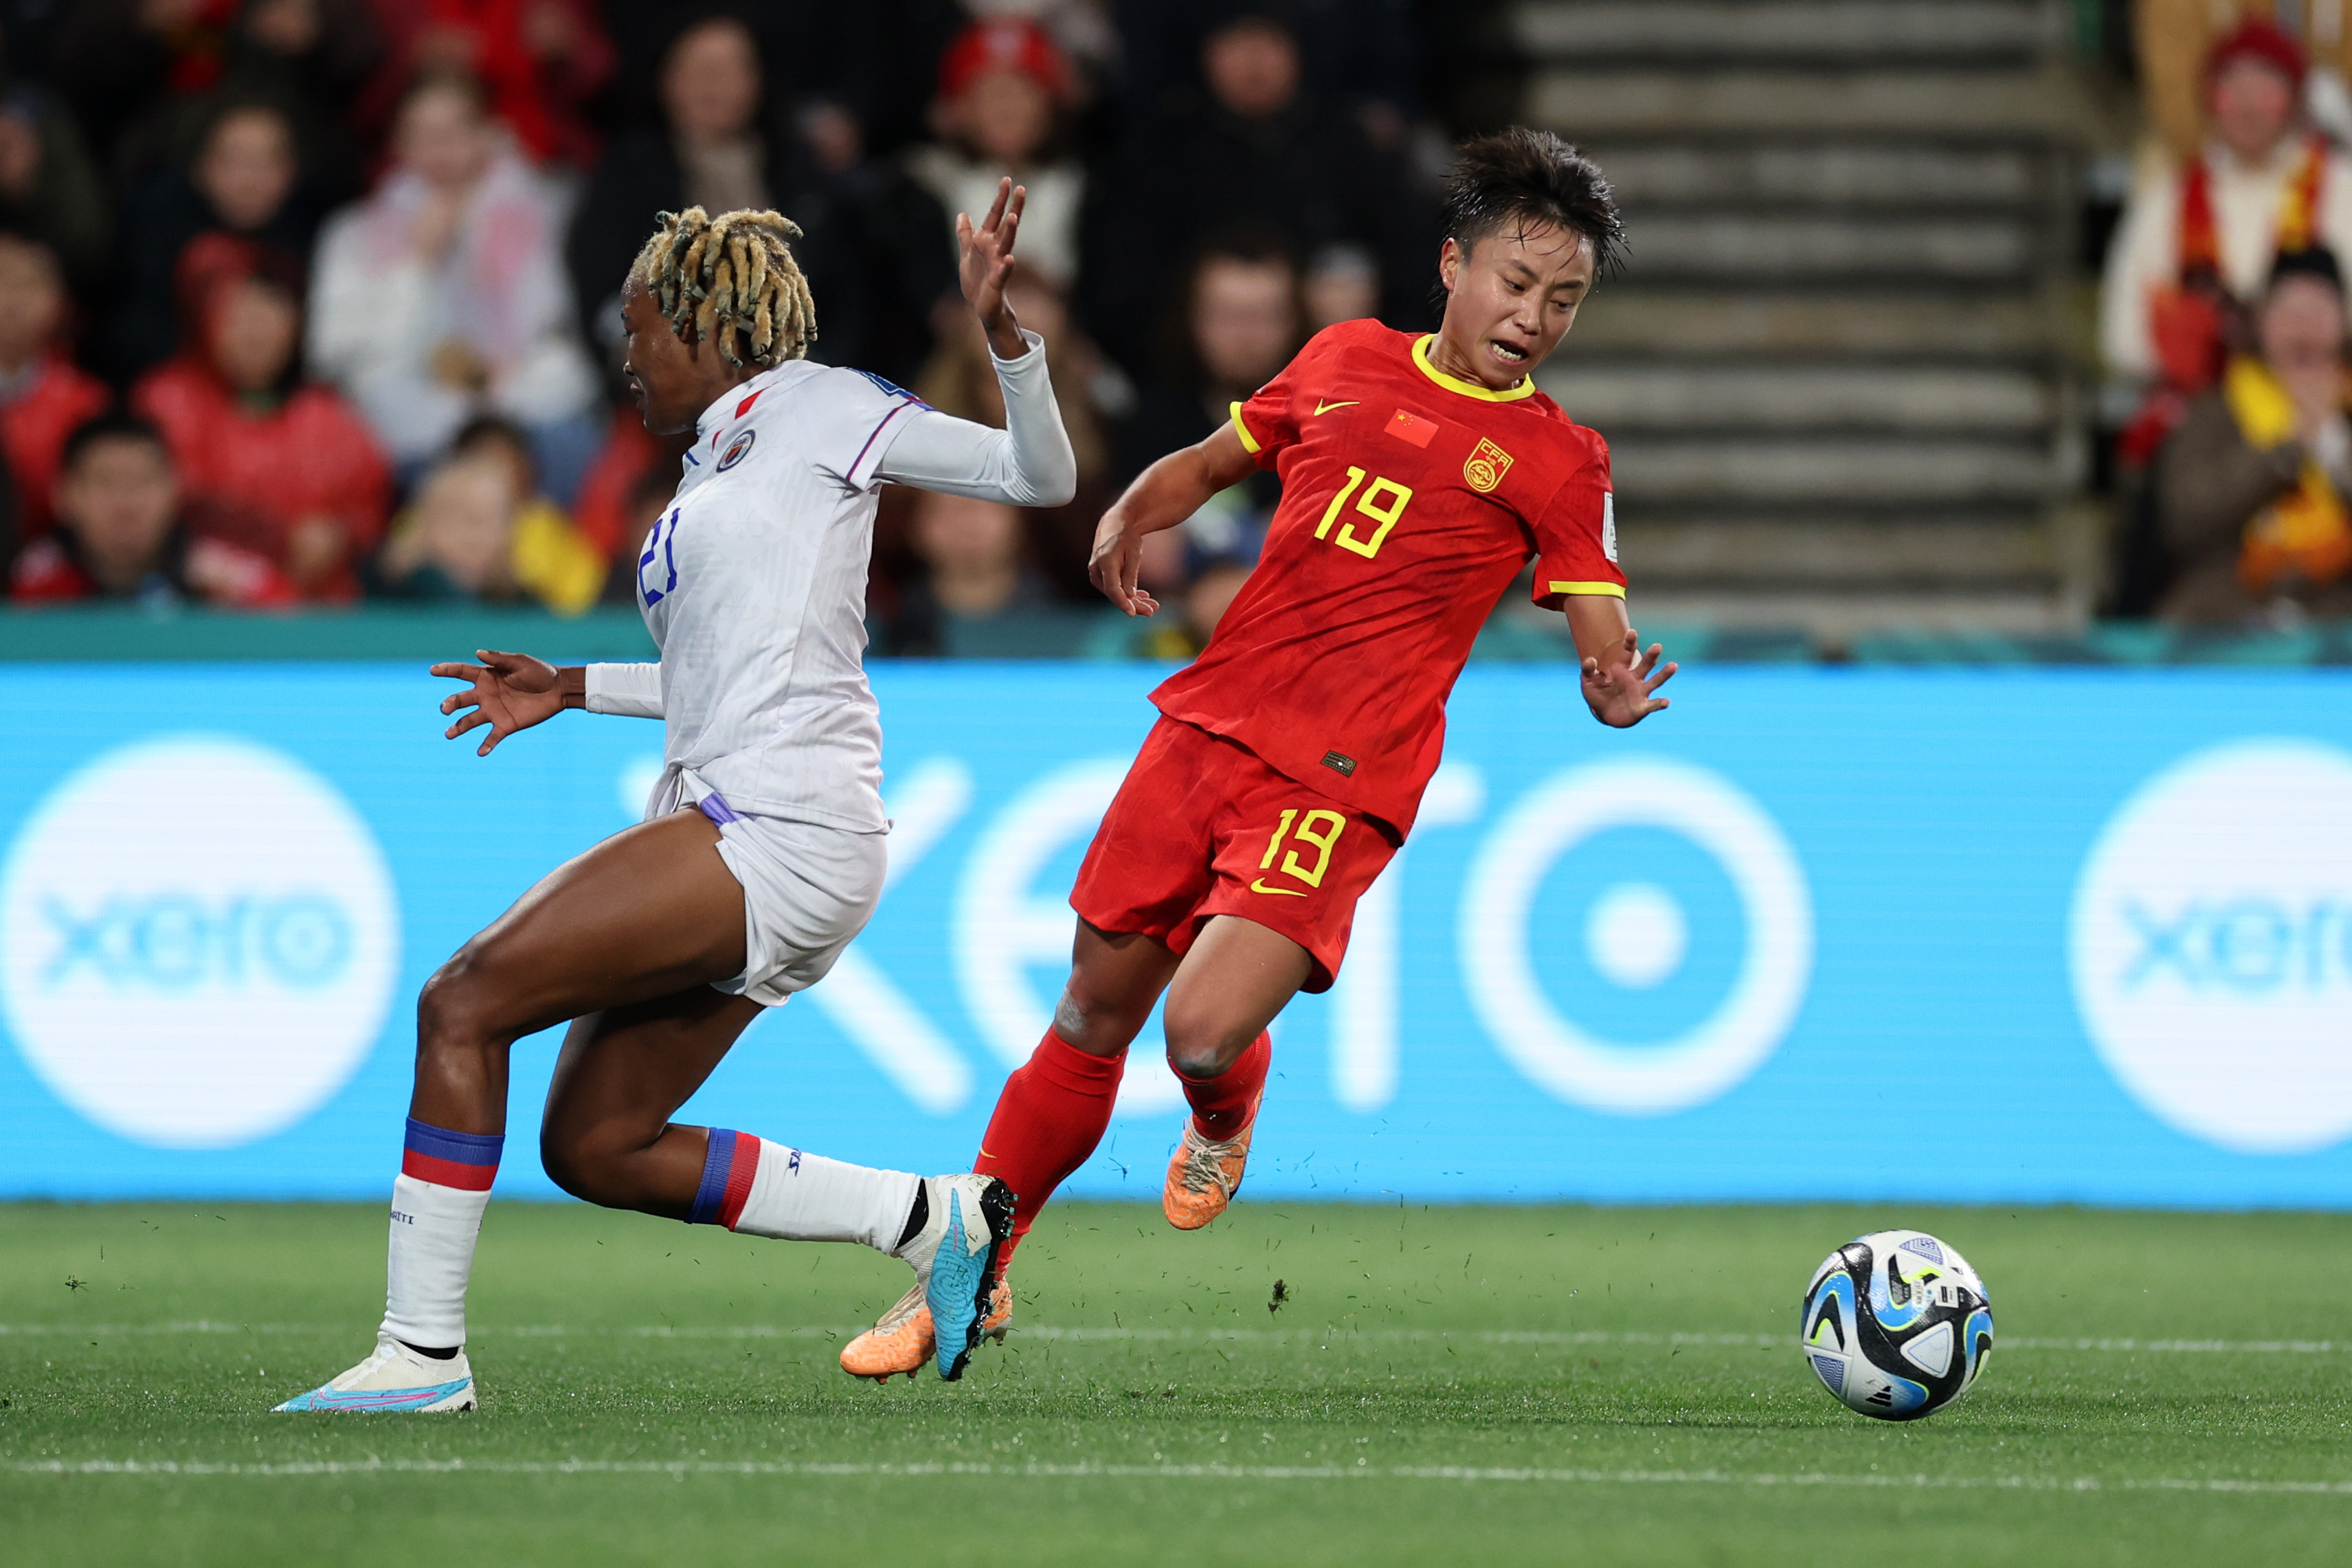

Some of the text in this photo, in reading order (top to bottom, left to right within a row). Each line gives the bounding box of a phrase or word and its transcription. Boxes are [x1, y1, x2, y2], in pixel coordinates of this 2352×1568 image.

[1480, 442, 1509, 467] CFA
[638, 508, 681, 608] 21
[1314, 465, 1413, 559] 19
[1259, 809, 1347, 888] 19
[37, 890, 355, 996] xero
[2116, 893, 2352, 996] xer
